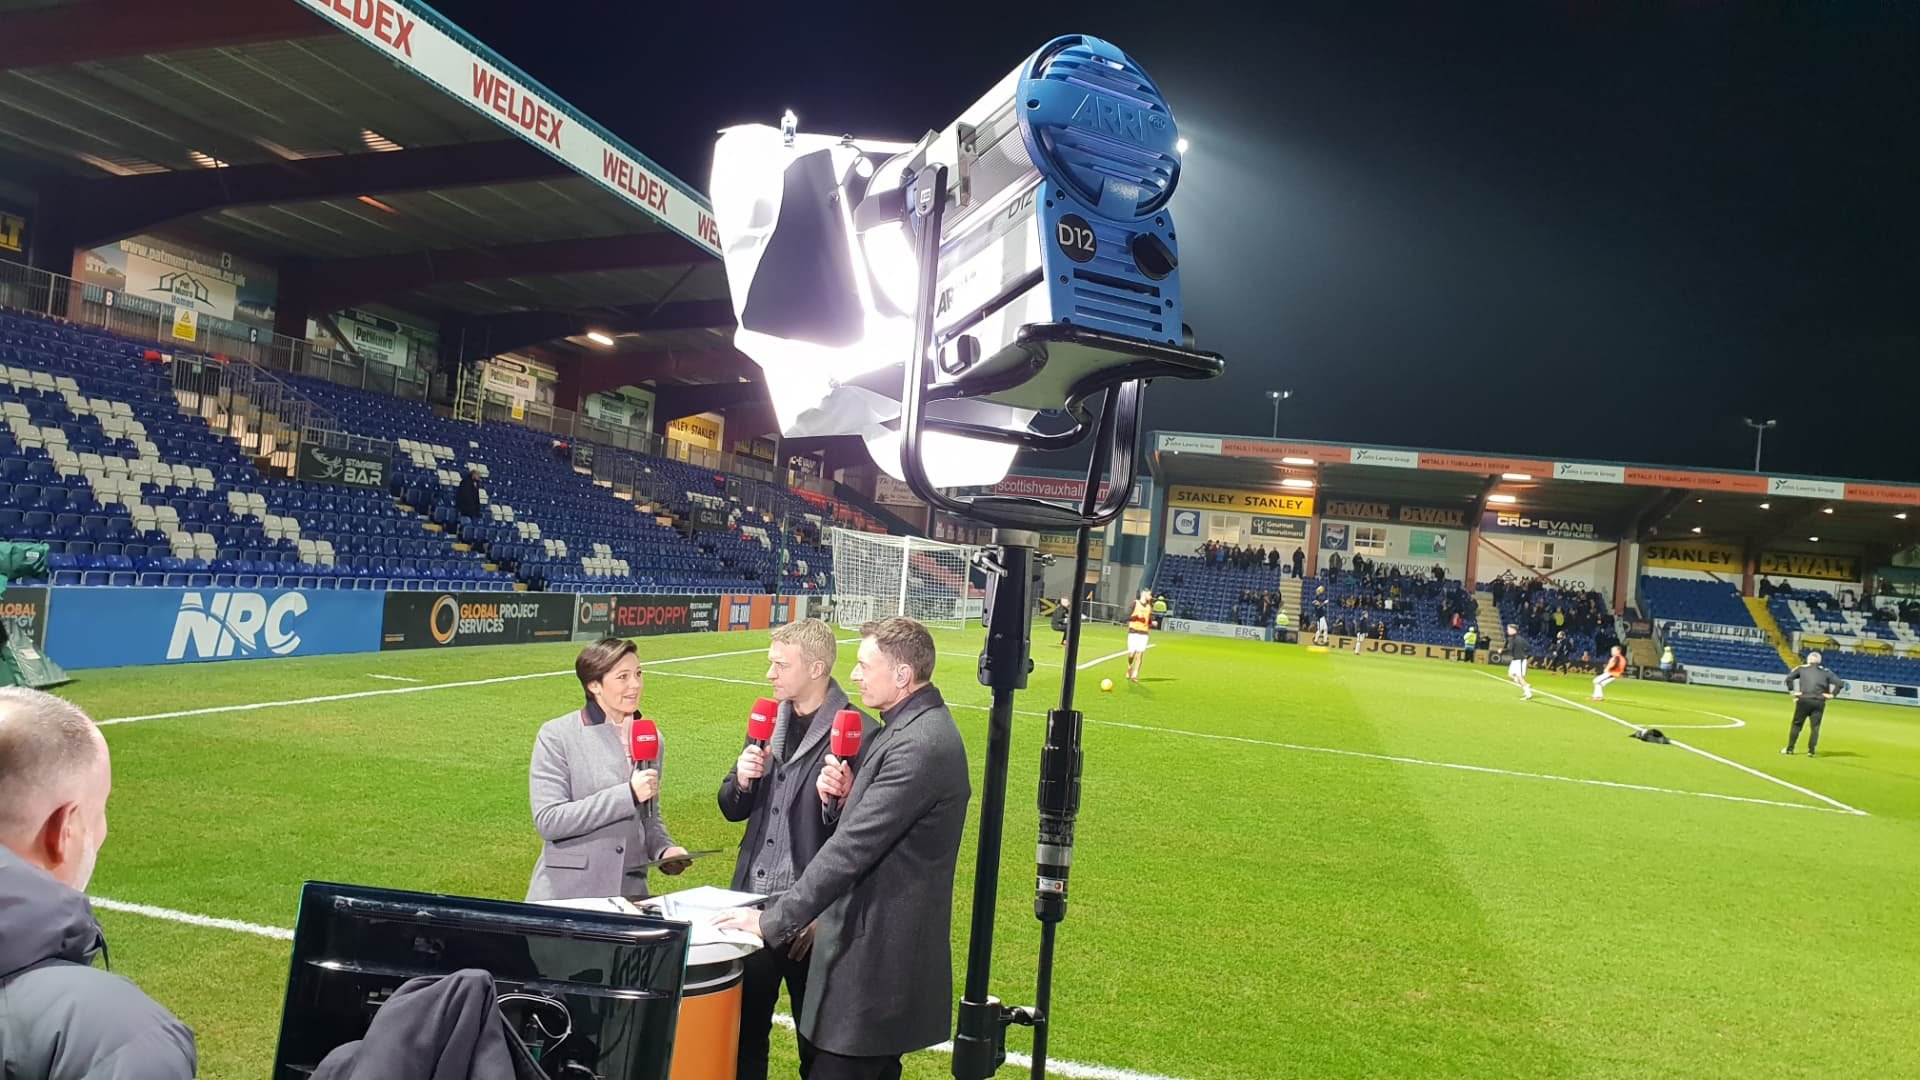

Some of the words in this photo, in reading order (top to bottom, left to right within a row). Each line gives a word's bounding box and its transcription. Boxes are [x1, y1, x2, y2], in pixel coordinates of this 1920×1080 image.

[319, 0, 414, 58] LDEX
[472, 63, 564, 149] WELDEX
[1071, 93, 1144, 142] ARRI
[603, 147, 668, 215] WELDEX
[1008, 190, 1032, 219] D12
[697, 210, 722, 250] WEL
[1058, 223, 1095, 252] D12
[106, 291, 113, 306] B
[250, 329, 257, 343] C
[692, 424, 716, 440] STANLEY
[1421, 456, 1445, 465] METALS
[344, 467, 381, 486] BAR
[998, 478, 1110, 499] scottishvauxhallm
[1178, 491, 1235, 505] STANLEY
[1244, 496, 1304, 510] STANLEY
[1328, 502, 1390, 520] DEWALT
[1402, 507, 1465, 526] DEWALT
[1497, 517, 1594, 532] CRC-EVANS
[1647, 546, 1732, 565] STANLEY
[0, 603, 36, 617] LOBAL
[460, 603, 498, 619] GLOBAL
[499, 602, 540, 618] PROJECT
[166, 592, 308, 660] NRC
[458, 618, 504, 634] SERVICES
[1169, 620, 1190, 631] ERG
[1236, 626, 1256, 636] ERG
[1367, 641, 1416, 656] JOB
